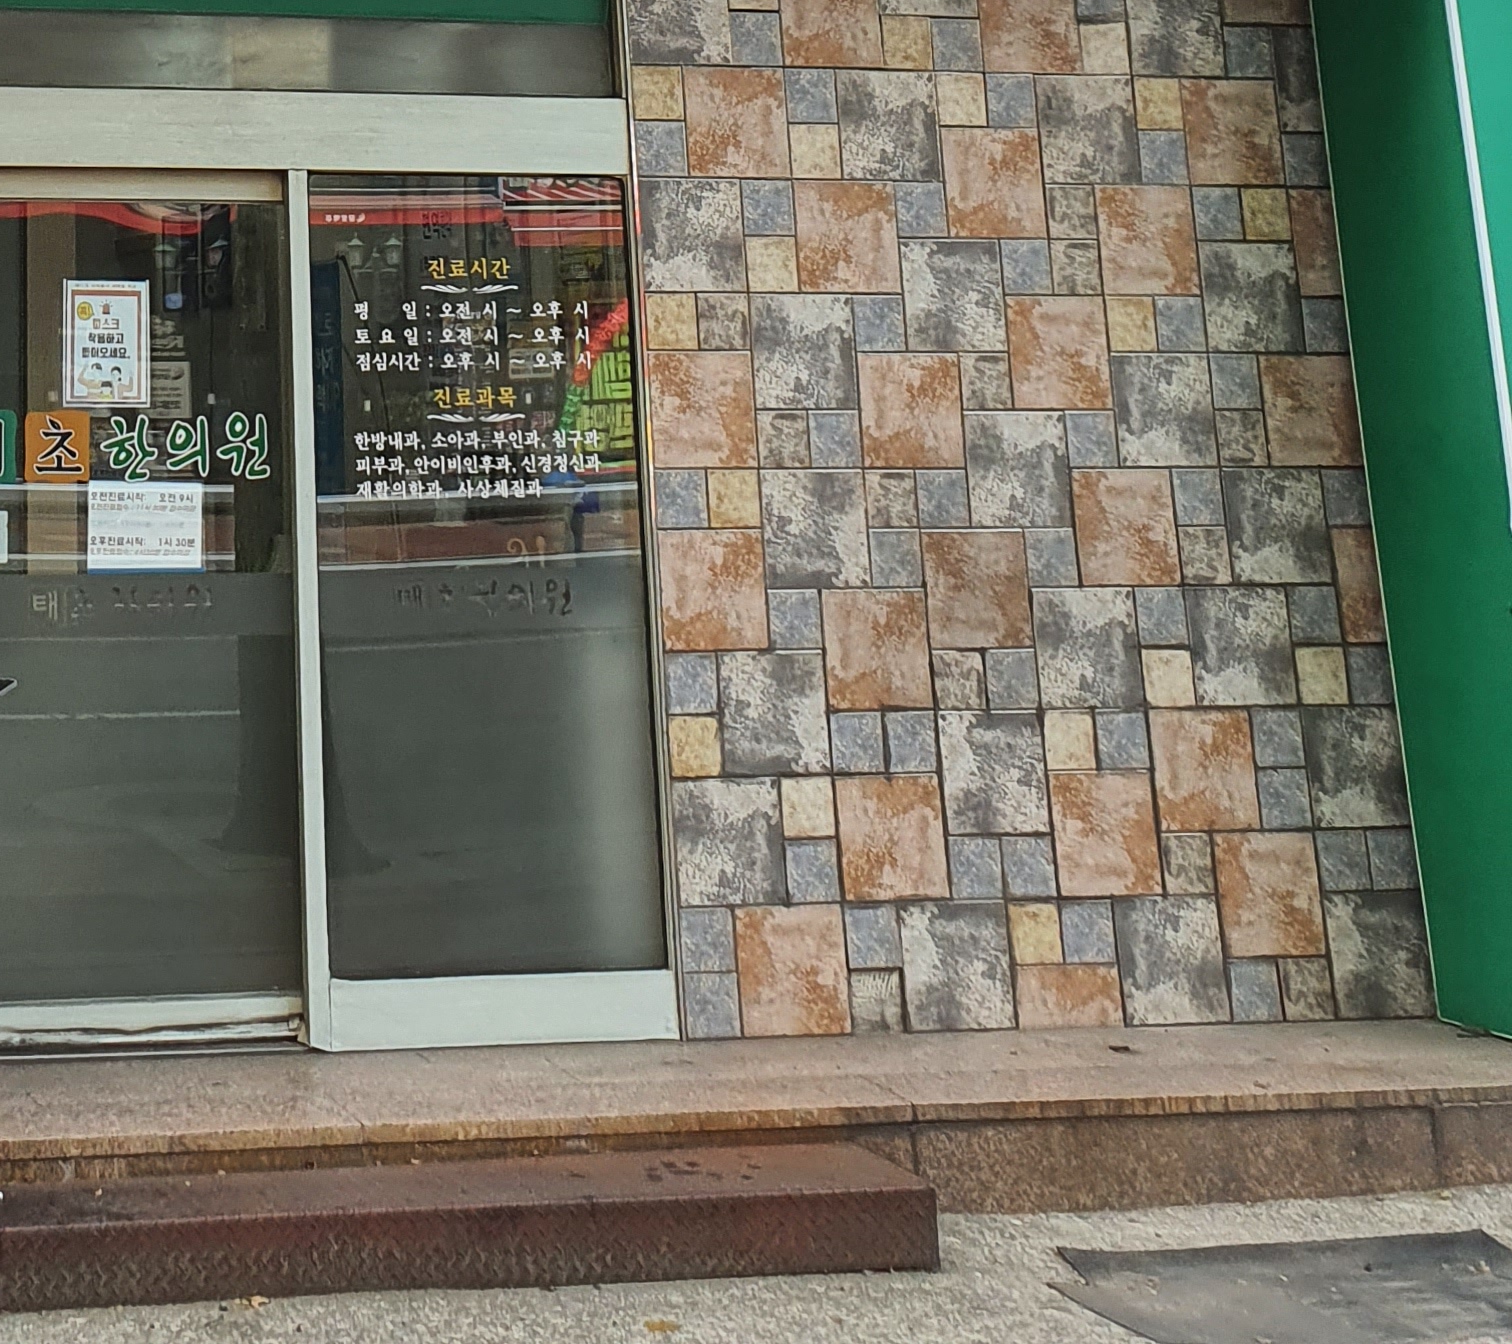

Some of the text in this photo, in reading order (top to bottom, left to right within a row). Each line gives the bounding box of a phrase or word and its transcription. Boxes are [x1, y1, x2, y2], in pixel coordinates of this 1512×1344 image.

[427, 258, 511, 280] 진료시간
[439, 301, 472, 321] 오전
[483, 300, 498, 321] 시
[531, 300, 563, 321] 오후
[573, 300, 589, 319] 시
[439, 327, 472, 346] 오전
[484, 326, 499, 346] 시
[532, 327, 565, 346] 오후
[576, 326, 591, 345] 시
[356, 352, 422, 371] 점심시간
[440, 352, 474, 371] 오후
[485, 351, 500, 371] 시
[533, 351, 566, 371] 오후
[433, 387, 517, 408] 진료과목
[552, 429, 600, 449] 침구과
